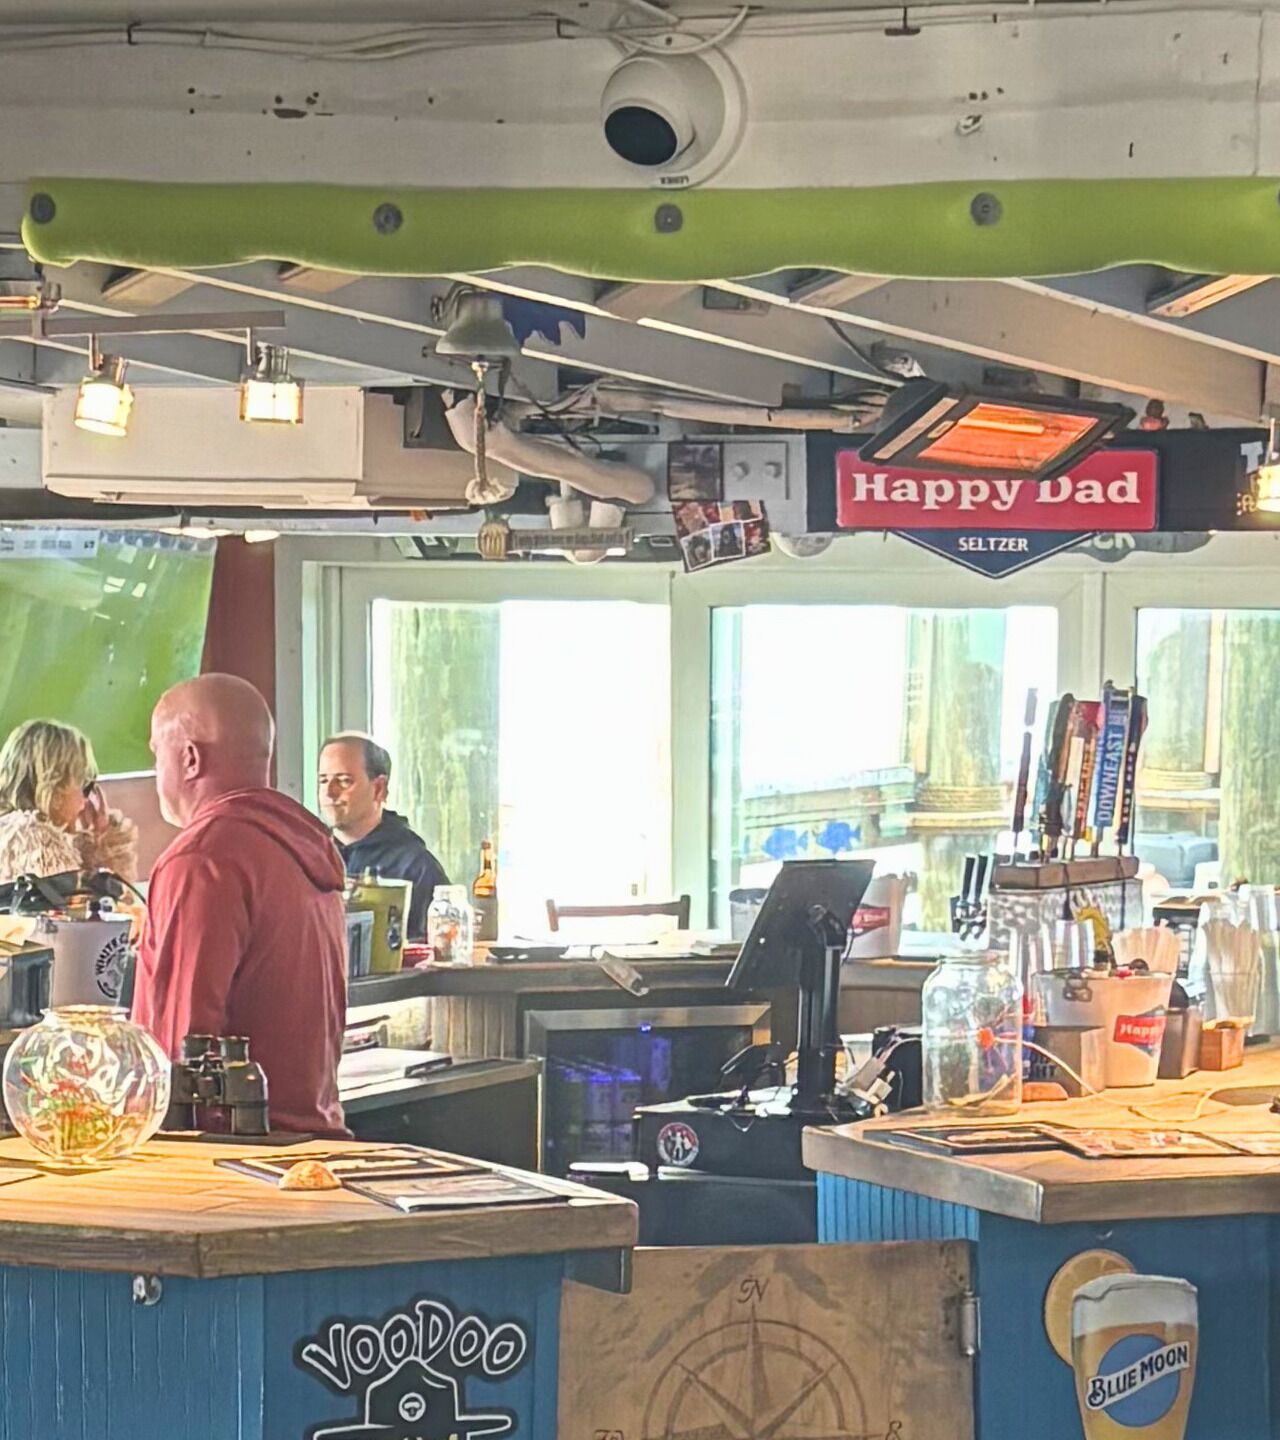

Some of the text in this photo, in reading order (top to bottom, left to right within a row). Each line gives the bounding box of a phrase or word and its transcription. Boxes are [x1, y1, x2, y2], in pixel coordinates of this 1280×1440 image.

[851, 471, 1141, 511] Happy Dad
[958, 536, 1029, 553] SELTZER
[1097, 732, 1122, 822] DOWNEAST
[302, 1299, 527, 1390] VOODOO
[1087, 1344, 1188, 1407] BLUE MOON
